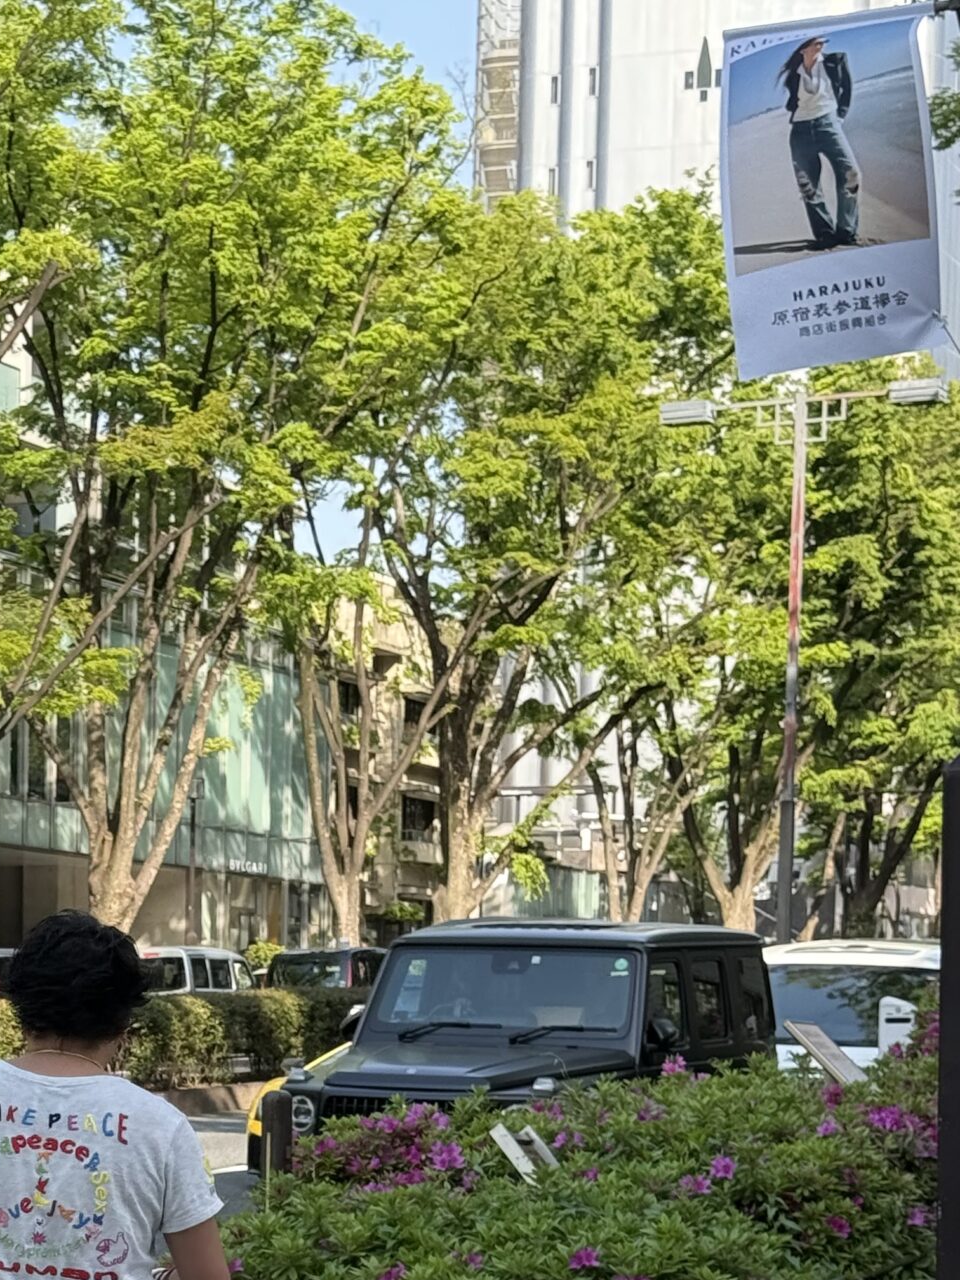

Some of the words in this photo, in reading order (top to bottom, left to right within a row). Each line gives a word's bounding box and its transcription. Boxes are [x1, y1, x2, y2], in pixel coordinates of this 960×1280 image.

[792, 275, 886, 302] HARAJUKU
[229, 858, 268, 875] BVLGARI
[48, 1112, 129, 1145] PEACE
[10, 1134, 90, 1162] peace
[91, 1171, 110, 1214] Sex
